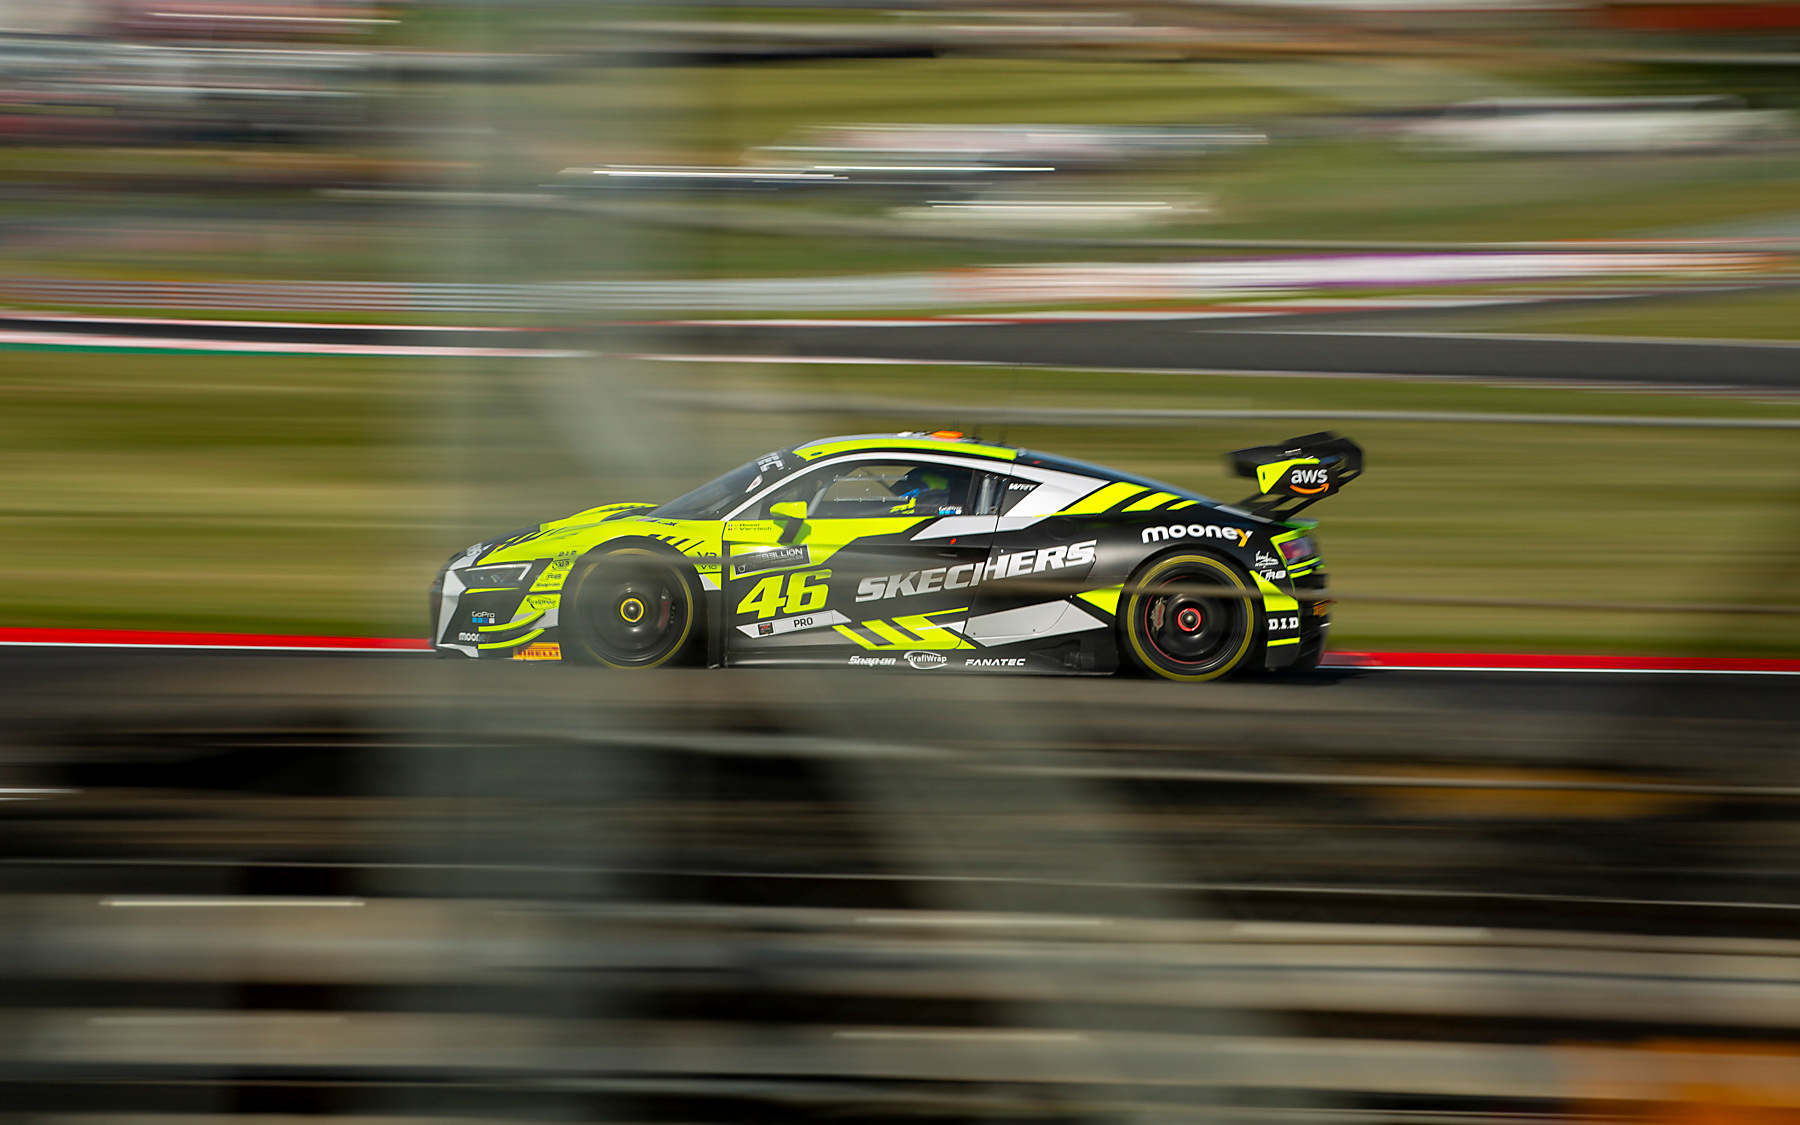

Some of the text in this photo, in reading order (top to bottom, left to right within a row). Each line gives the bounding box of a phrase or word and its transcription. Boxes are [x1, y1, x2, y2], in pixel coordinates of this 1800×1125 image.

[1290, 469, 1329, 484] aws
[1008, 482, 1038, 491] WRT
[1141, 524, 1253, 547] mooney
[855, 539, 1098, 603] SKECHERS
[736, 569, 832, 619] 46
[471, 610, 496, 618] GoPro
[793, 617, 814, 628] PRO
[1268, 616, 1299, 630] D.I.D
[848, 655, 897, 667] Snap-on
[907, 653, 948, 664] GrafiWrap
[964, 658, 1026, 667] FANATEC
